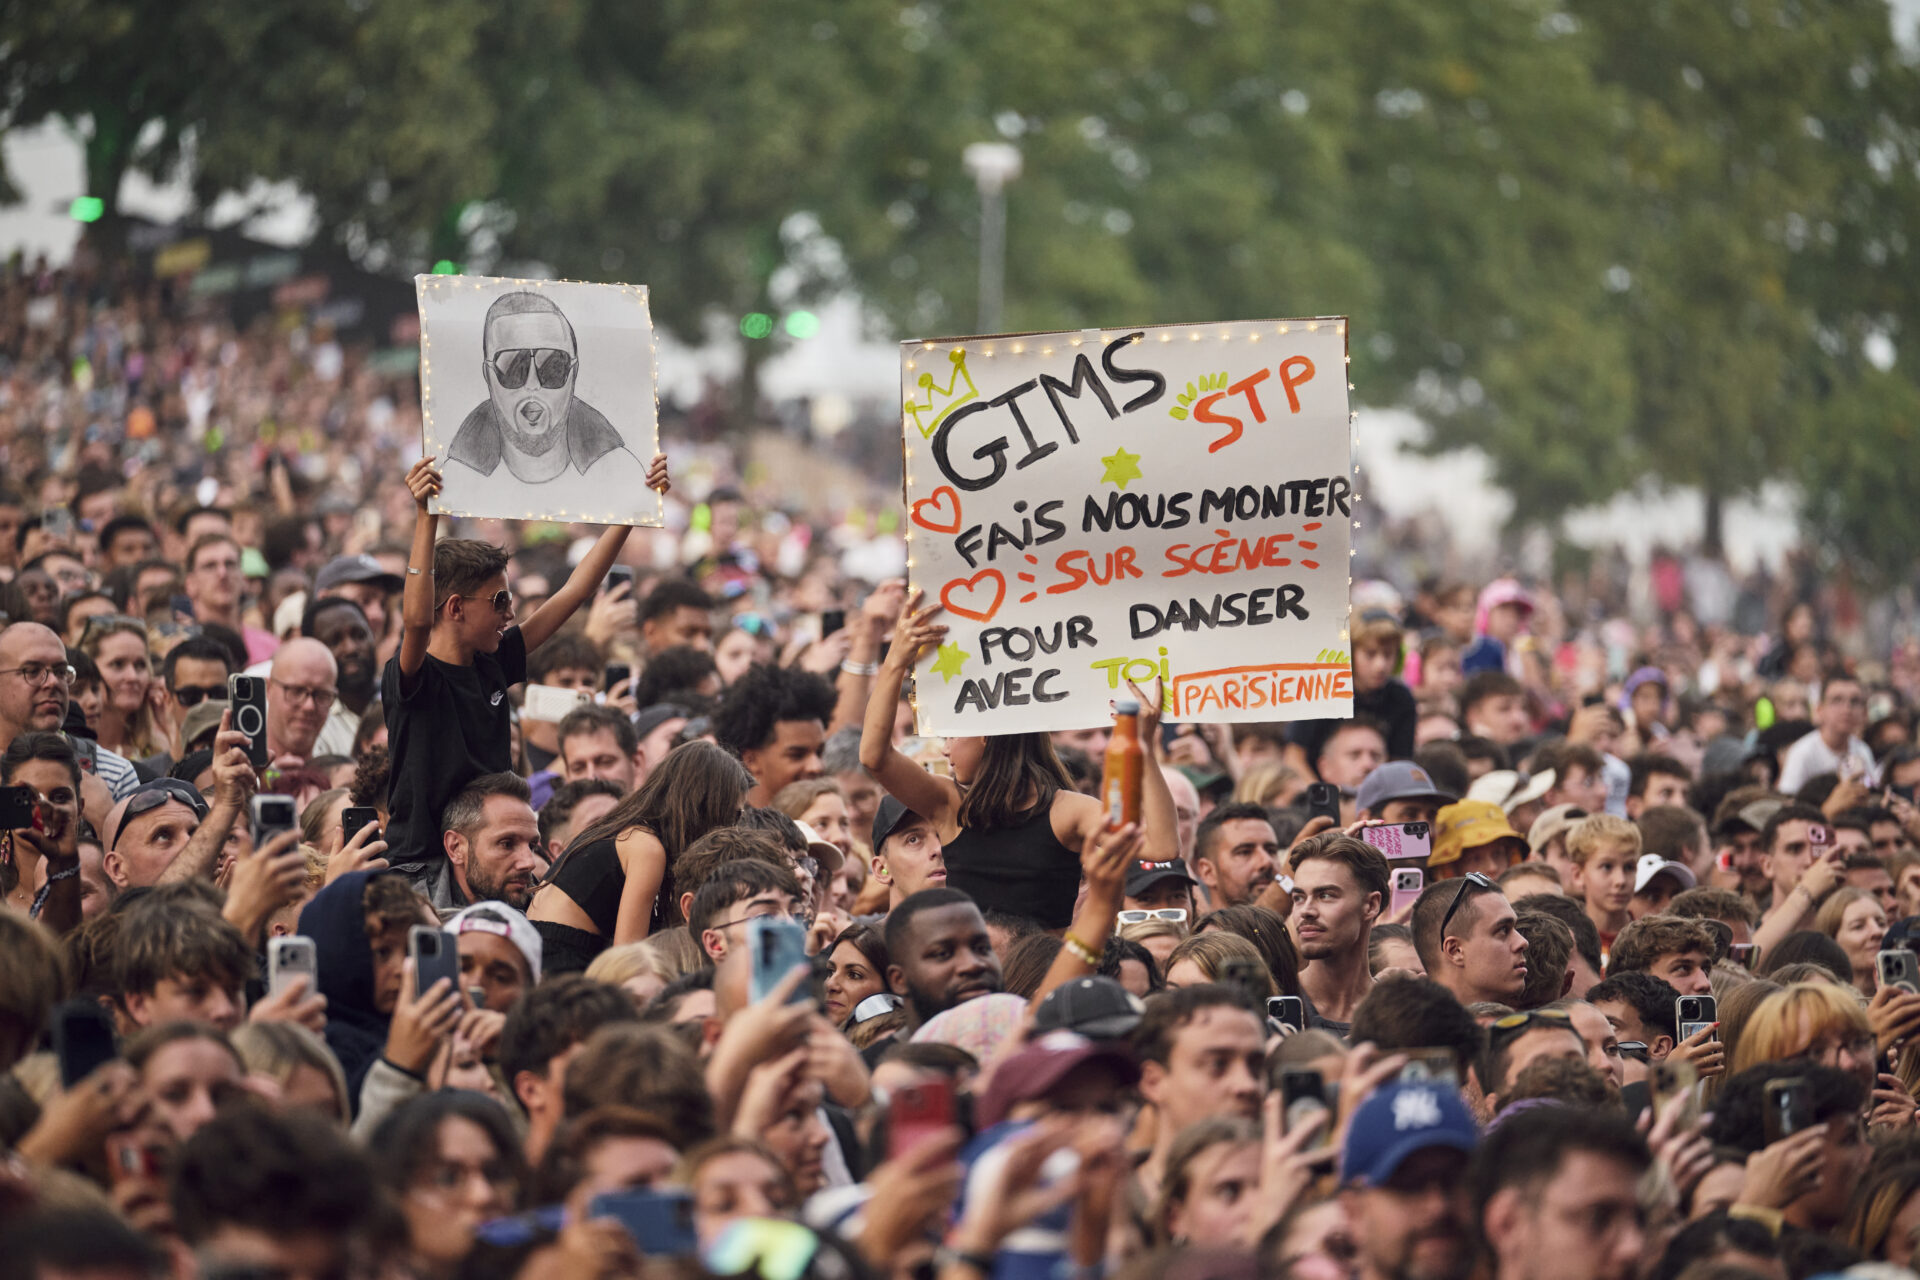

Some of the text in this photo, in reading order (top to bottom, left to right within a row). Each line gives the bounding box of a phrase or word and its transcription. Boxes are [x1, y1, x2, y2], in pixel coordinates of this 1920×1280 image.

[932, 331, 1315, 491] GIMS STP
[1082, 491, 1193, 533] NOUS
[1199, 476, 1351, 524] MONTER
[1046, 529, 1295, 594] SUR SCÈNE
[980, 584, 1310, 665] POUR DANSER
[955, 668, 1069, 714] AVEC
[1376, 828, 1385, 848] POR
[1384, 827, 1394, 855] AMOR
[1392, 827, 1402, 856] MORE
